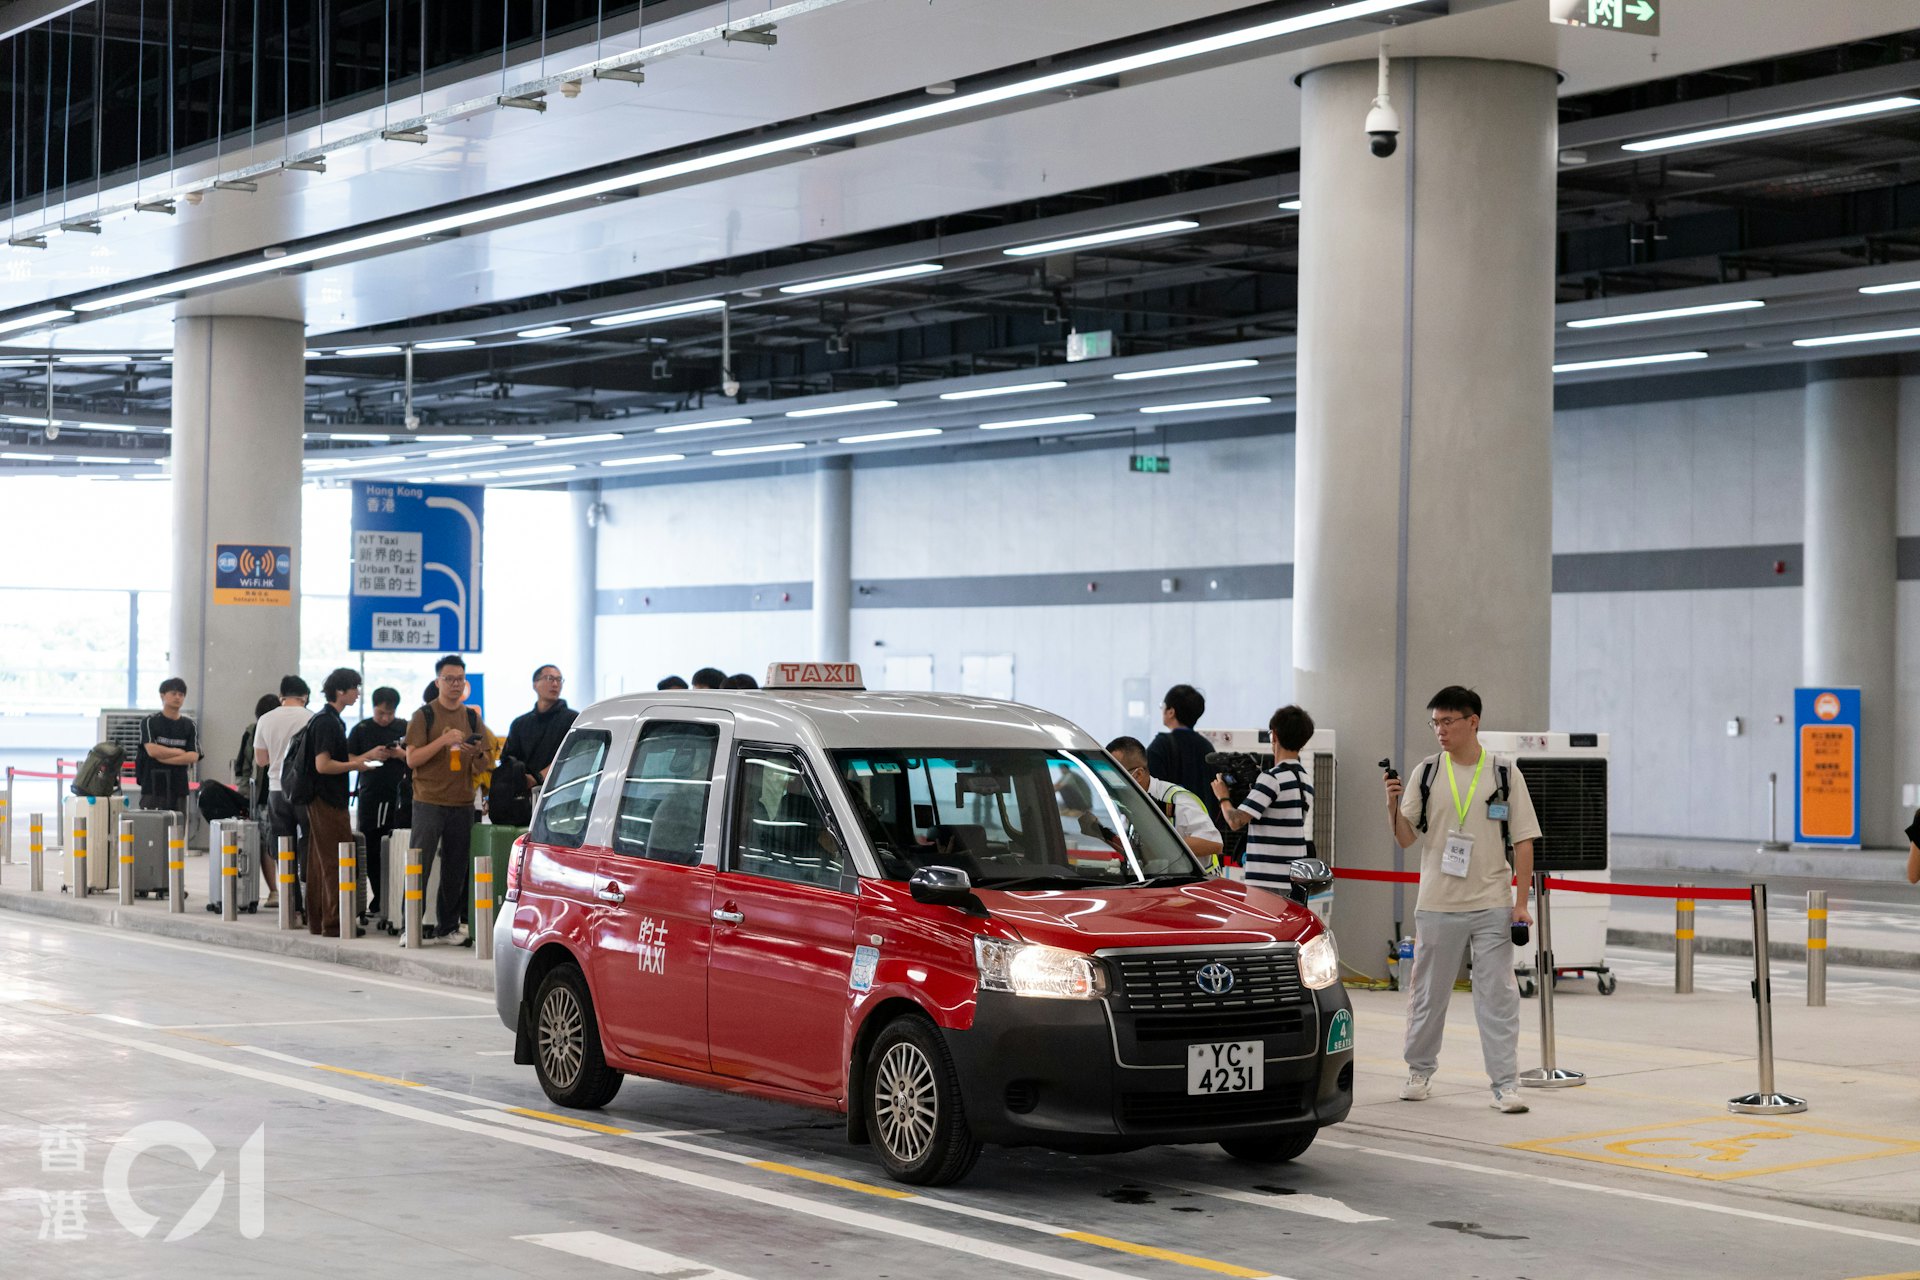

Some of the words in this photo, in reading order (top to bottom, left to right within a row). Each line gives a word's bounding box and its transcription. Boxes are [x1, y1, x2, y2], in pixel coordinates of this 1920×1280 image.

[367, 485, 394, 497] Hong
[397, 487, 423, 499] Kong
[367, 497, 395, 513] 香港
[359, 535, 374, 545] NT
[378, 535, 398, 545] Taxi
[359, 547, 417, 563] 新界的士
[359, 565, 390, 575] Urban
[394, 565, 414, 575] Taxi
[359, 577, 417, 592] 市區的士
[377, 617, 402, 627] Fleet
[406, 617, 426, 627] Taxi
[377, 629, 435, 645] 車隊的士
[781, 664, 855, 682] TAXI
[638, 917, 669, 946] 的士
[637, 944, 666, 975] TAXI
[1336, 1012, 1349, 1023] TAXI
[1340, 1022, 1347, 1038] 4
[1334, 1039, 1352, 1050] SEATS
[1211, 1044, 1241, 1068] YC
[1199, 1066, 1253, 1093] 4231
